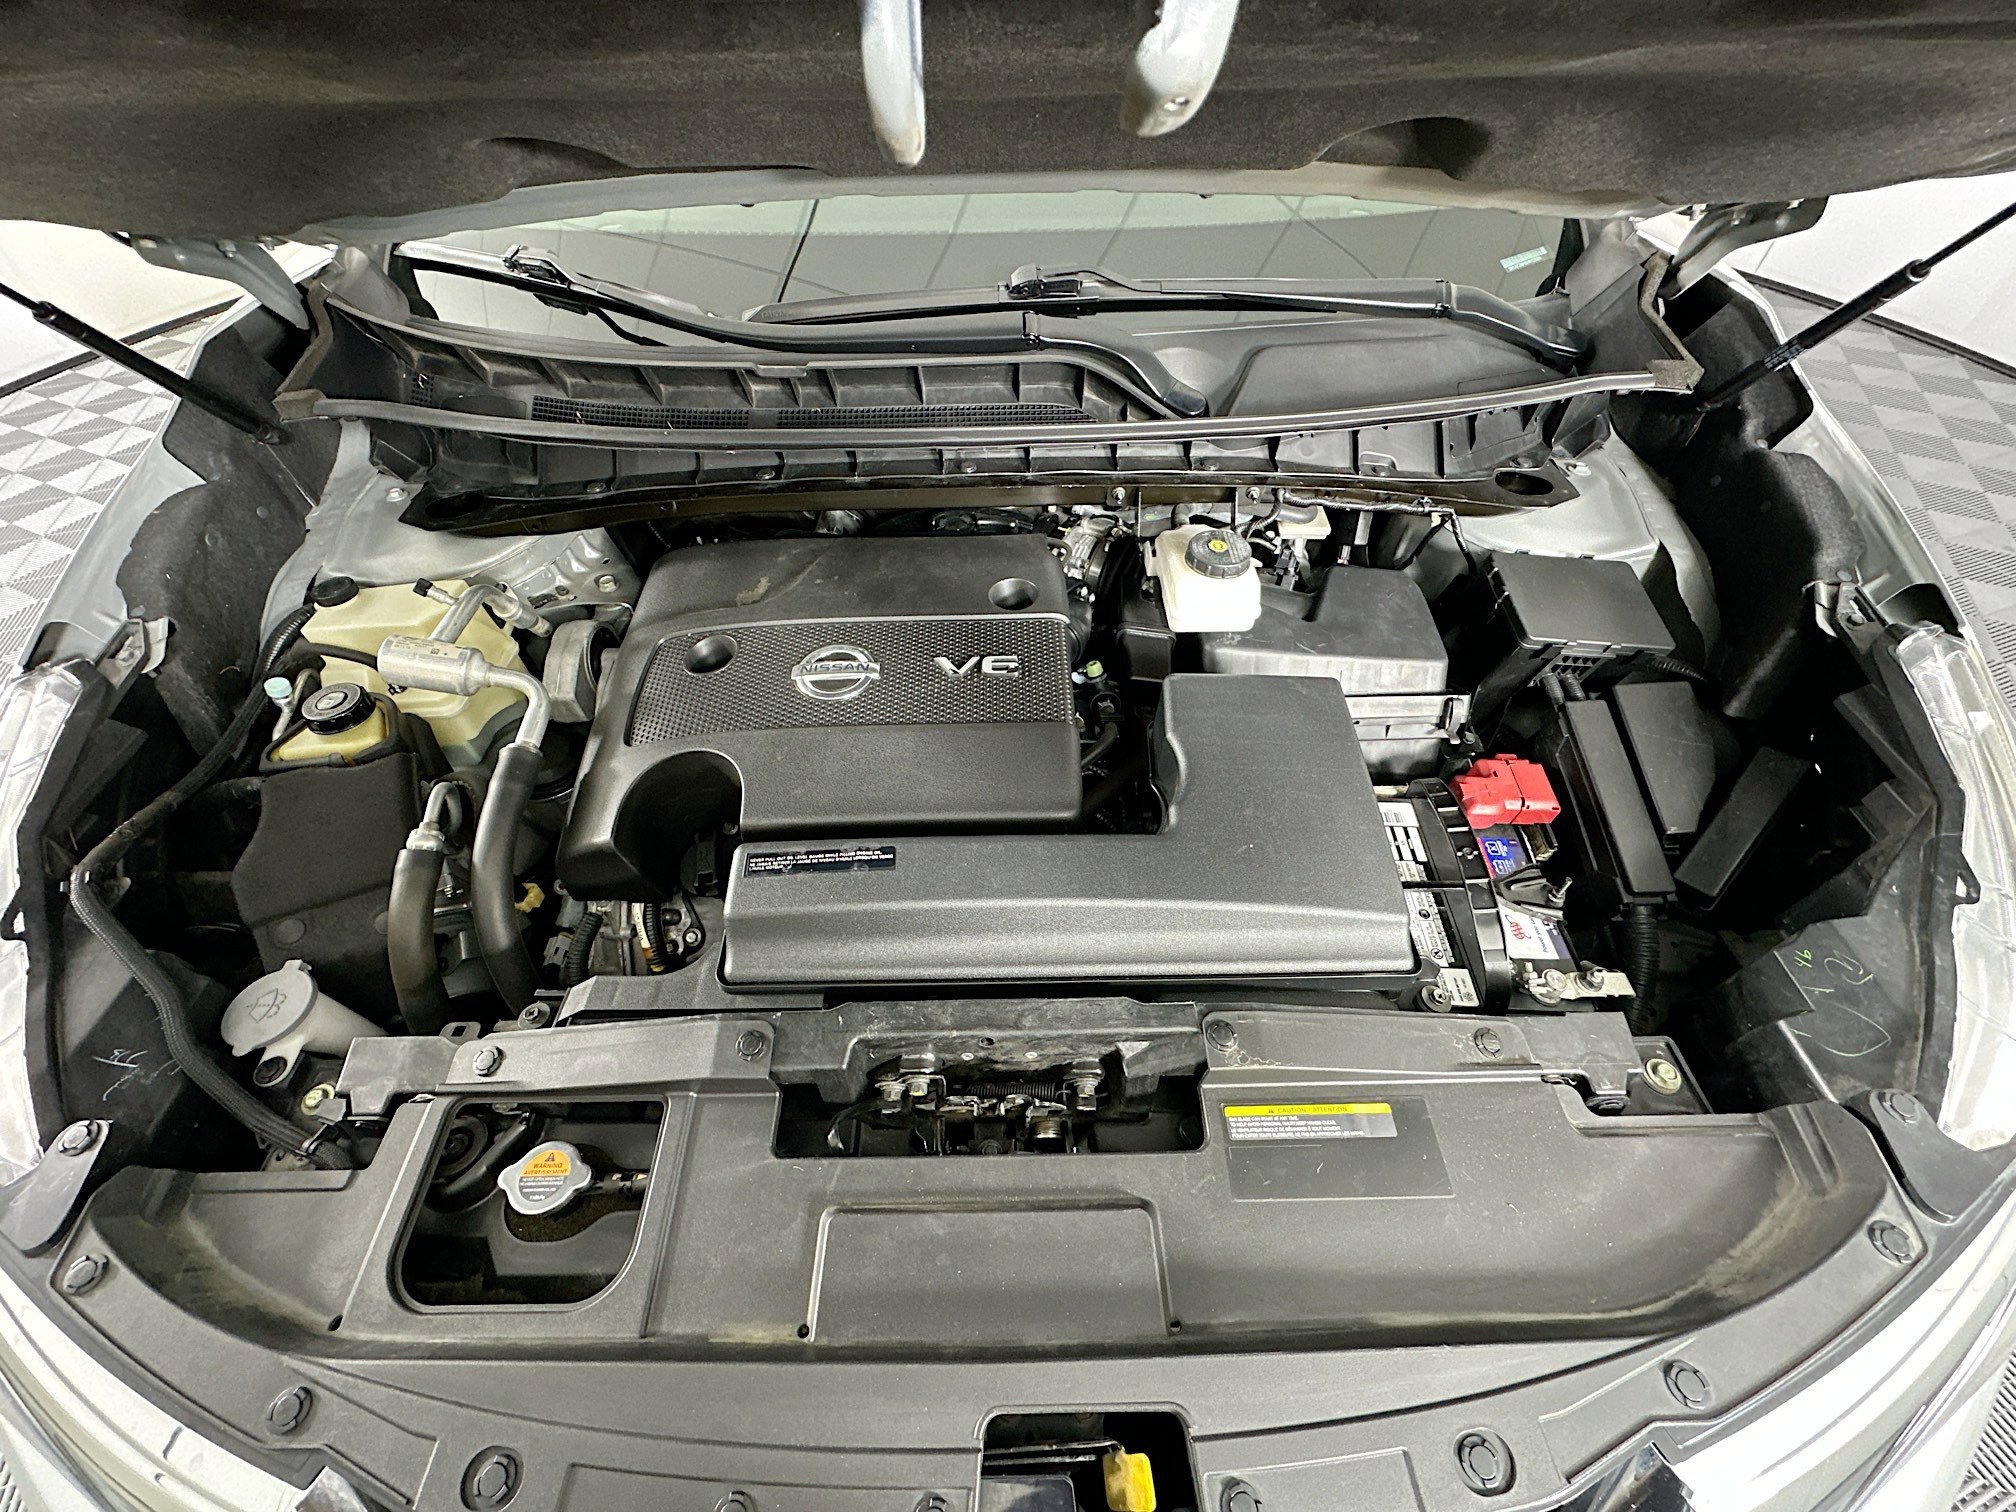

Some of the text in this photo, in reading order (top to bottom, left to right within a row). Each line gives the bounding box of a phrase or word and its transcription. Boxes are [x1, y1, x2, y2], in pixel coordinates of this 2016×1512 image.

[801, 662, 870, 672] NISSAN
[934, 656, 1018, 676] V6
[1538, 936, 1549, 952] Power
